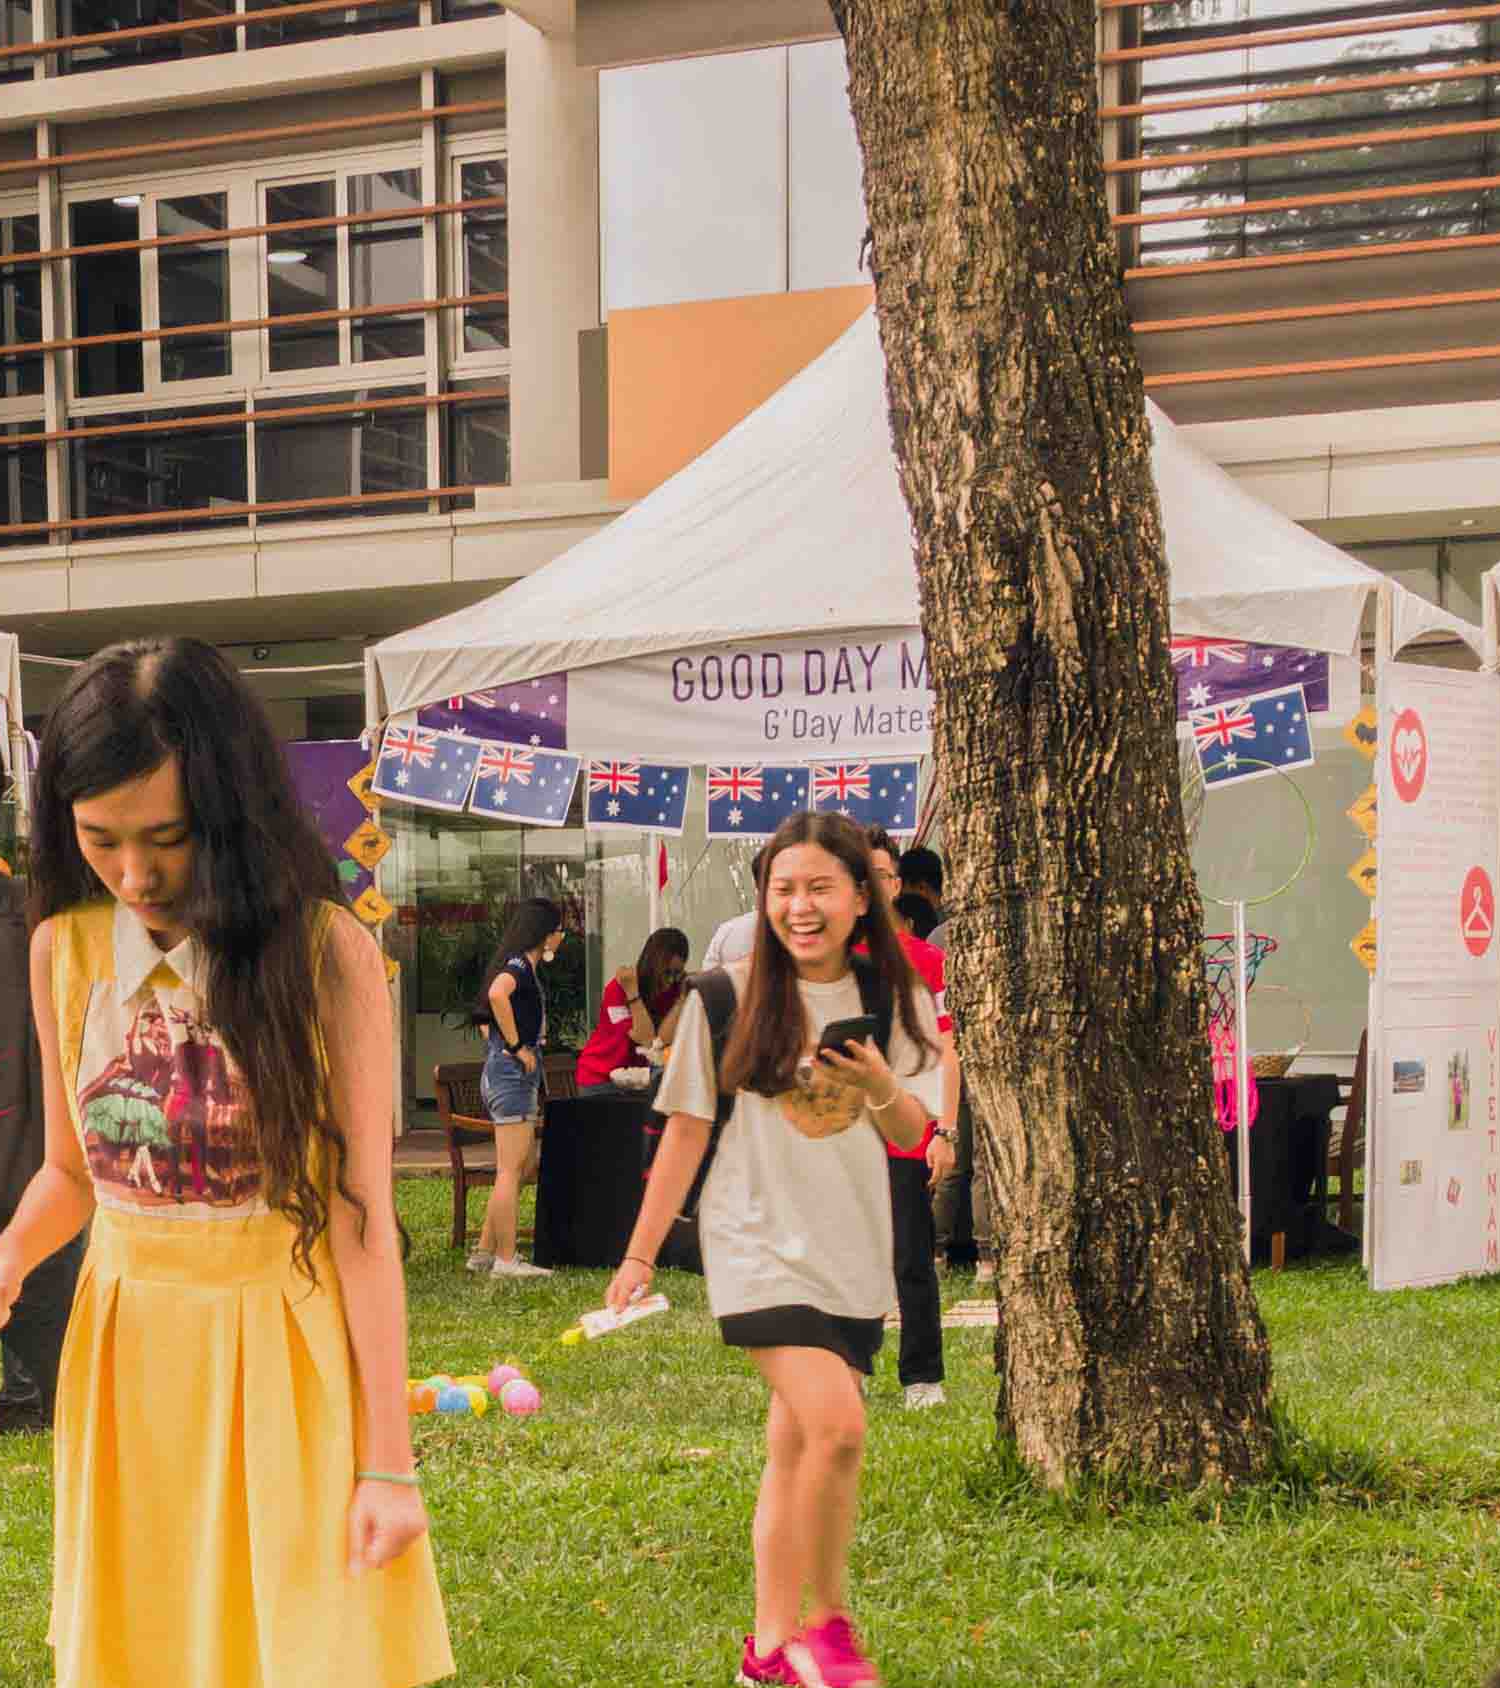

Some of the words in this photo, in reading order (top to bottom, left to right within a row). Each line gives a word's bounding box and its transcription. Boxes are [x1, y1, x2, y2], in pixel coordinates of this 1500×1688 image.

[672, 652, 784, 703] GOOD
[803, 643, 884, 697] DAY
[763, 707, 843, 744] G'Day
[853, 704, 937, 737] Mates
